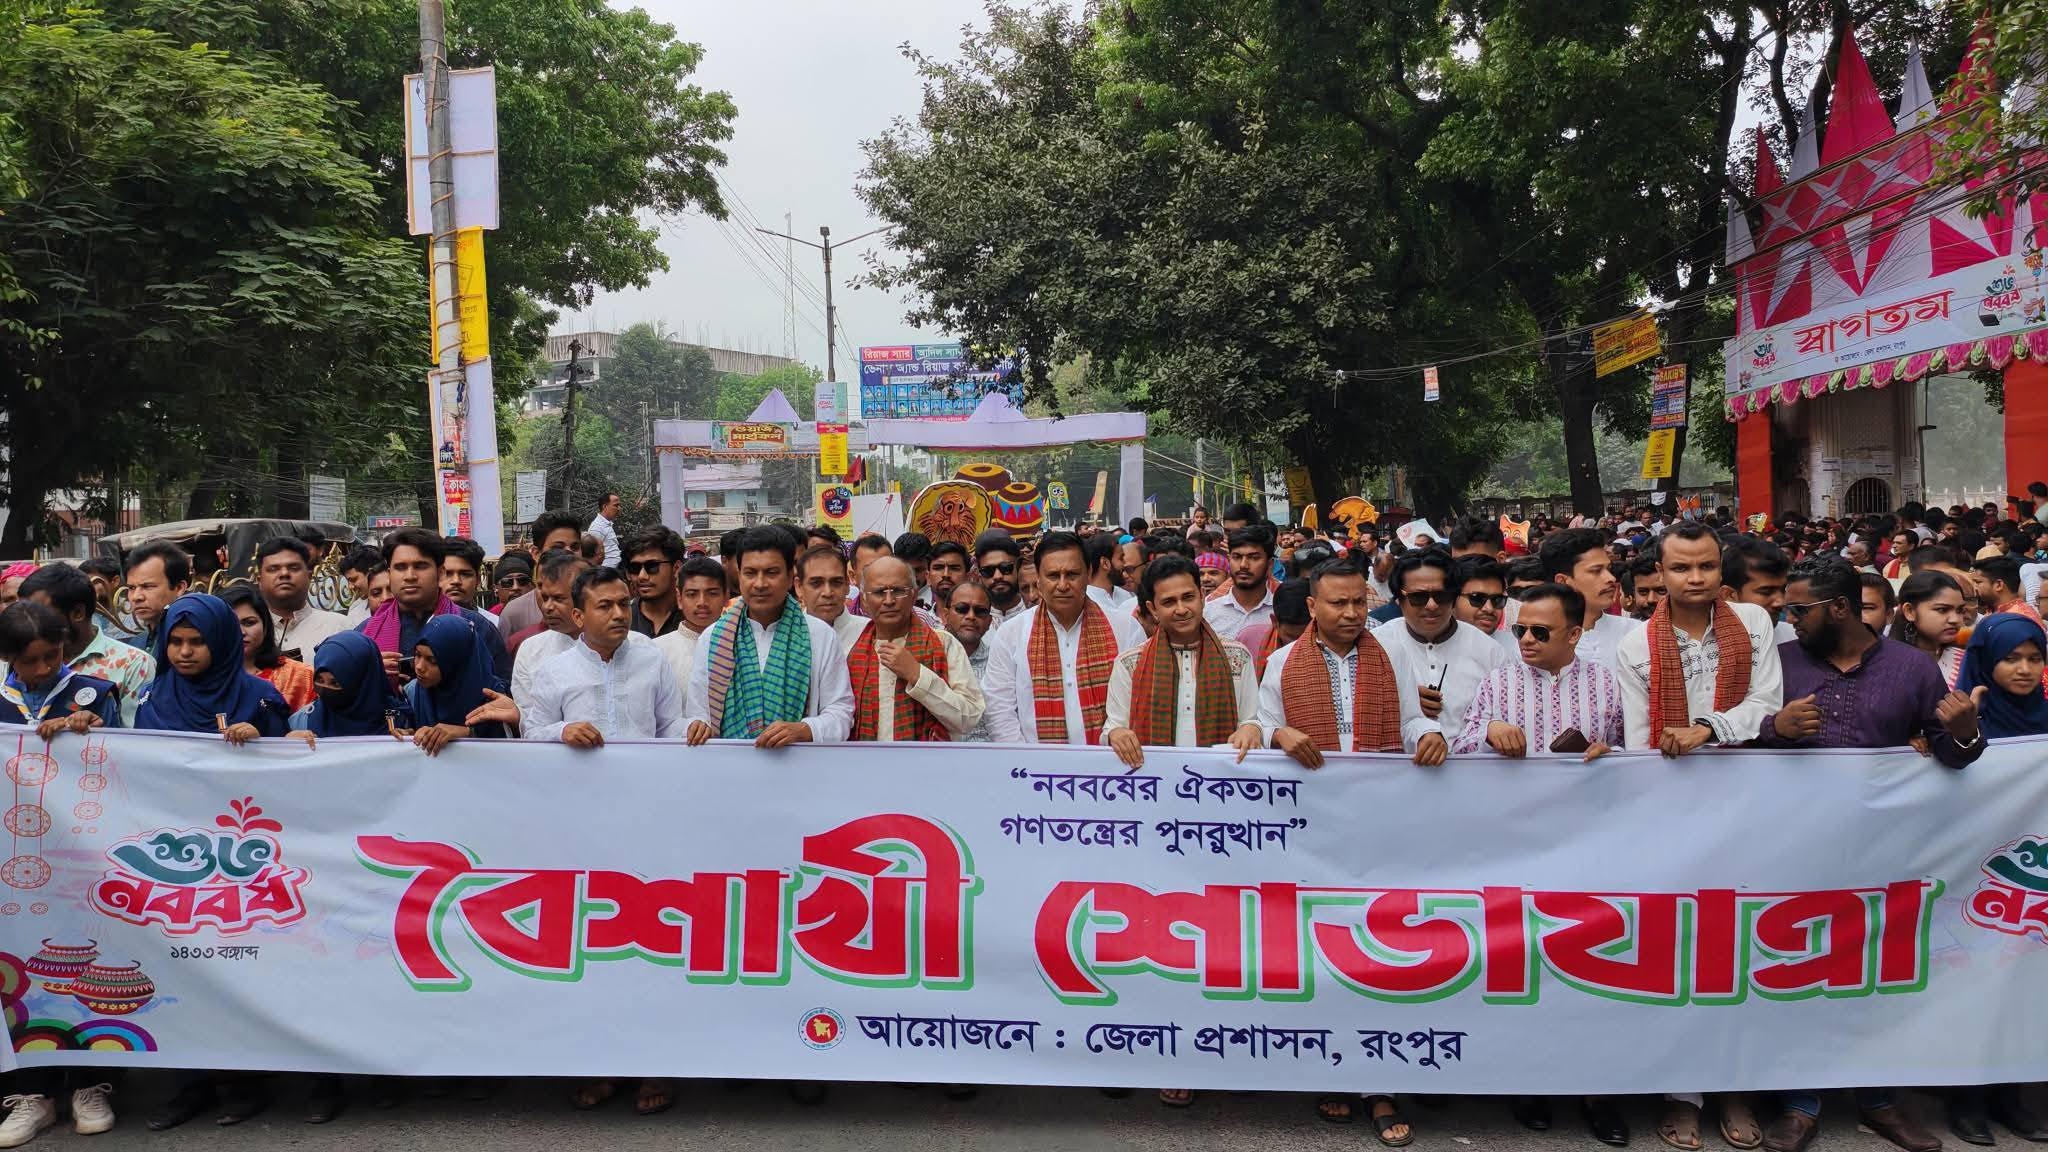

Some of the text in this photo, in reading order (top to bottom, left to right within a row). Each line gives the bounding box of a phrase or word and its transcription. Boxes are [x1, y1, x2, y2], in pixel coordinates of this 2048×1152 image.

[1794, 290, 1954, 354] স্বাগতম
[1010, 765, 1303, 806] “নববর্ষের ঐকতান
[112, 832, 272, 885] শুভ
[1000, 814, 1144, 848] গণতন্ত্রের
[98, 867, 296, 925] নববর্ষ
[352, 813, 1940, 1004] বৈশাখী শোভাযাত্রা
[170, 946, 260, 960] ১৪৩৩ বঙ্গাব্দ
[855, 1012, 1040, 1051] আয়োজনে
[1086, 1021, 1183, 1058] জেলা
[1194, 1023, 1342, 1066] প্রশাসন,
[1356, 1027, 1469, 1070] রংপুর
